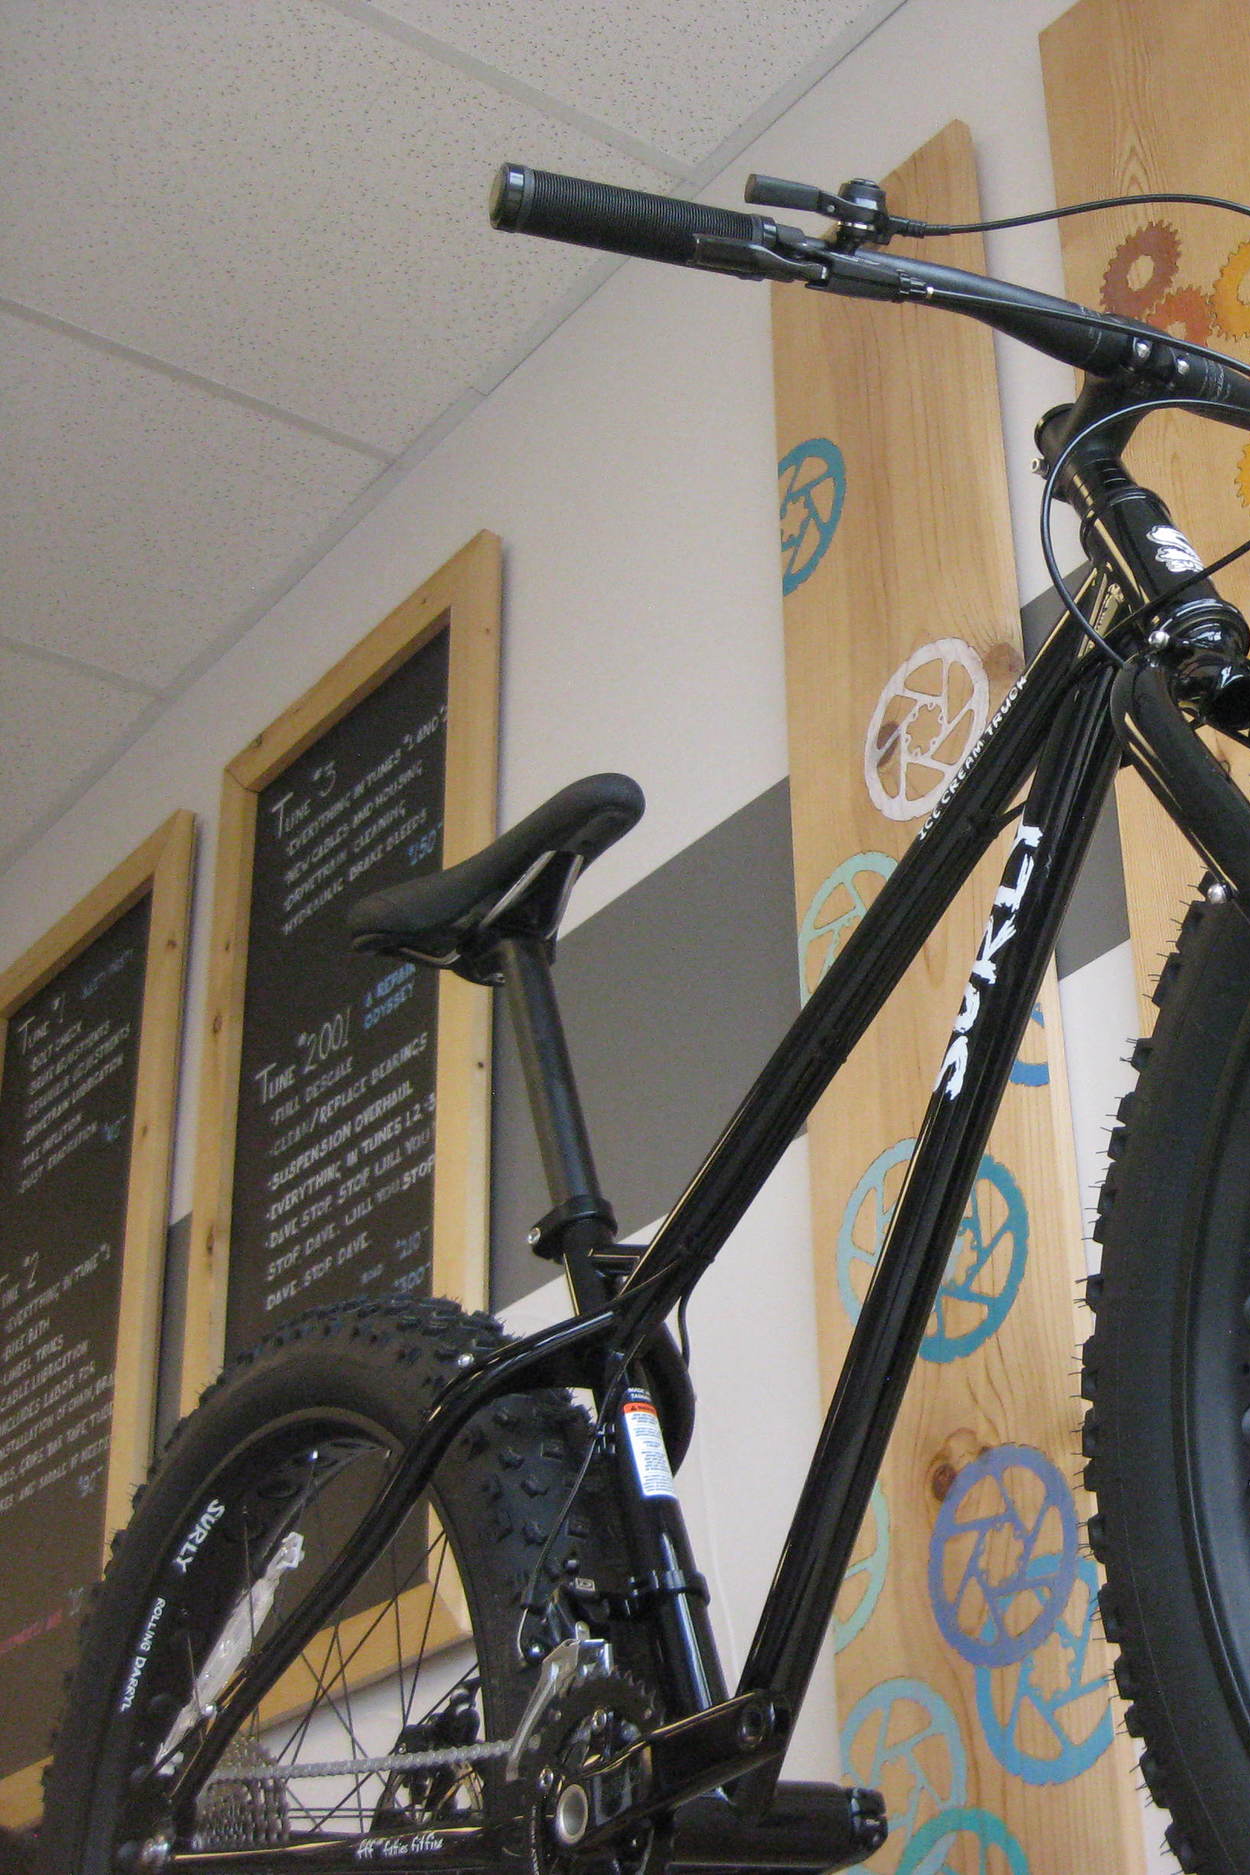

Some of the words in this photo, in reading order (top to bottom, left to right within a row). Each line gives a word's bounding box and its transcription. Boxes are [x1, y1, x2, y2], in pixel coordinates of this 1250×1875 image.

[271, 1158, 342, 1221] EVERYTHING
[361, 1116, 401, 1156] TUNES
[272, 1122, 352, 1189] SUSPENSION
[354, 1078, 413, 1131] OVERHAUL
[174, 1499, 226, 1573] SURLY
[140, 1597, 167, 1653] ROLLING
[121, 1656, 146, 1712] DARRYL
